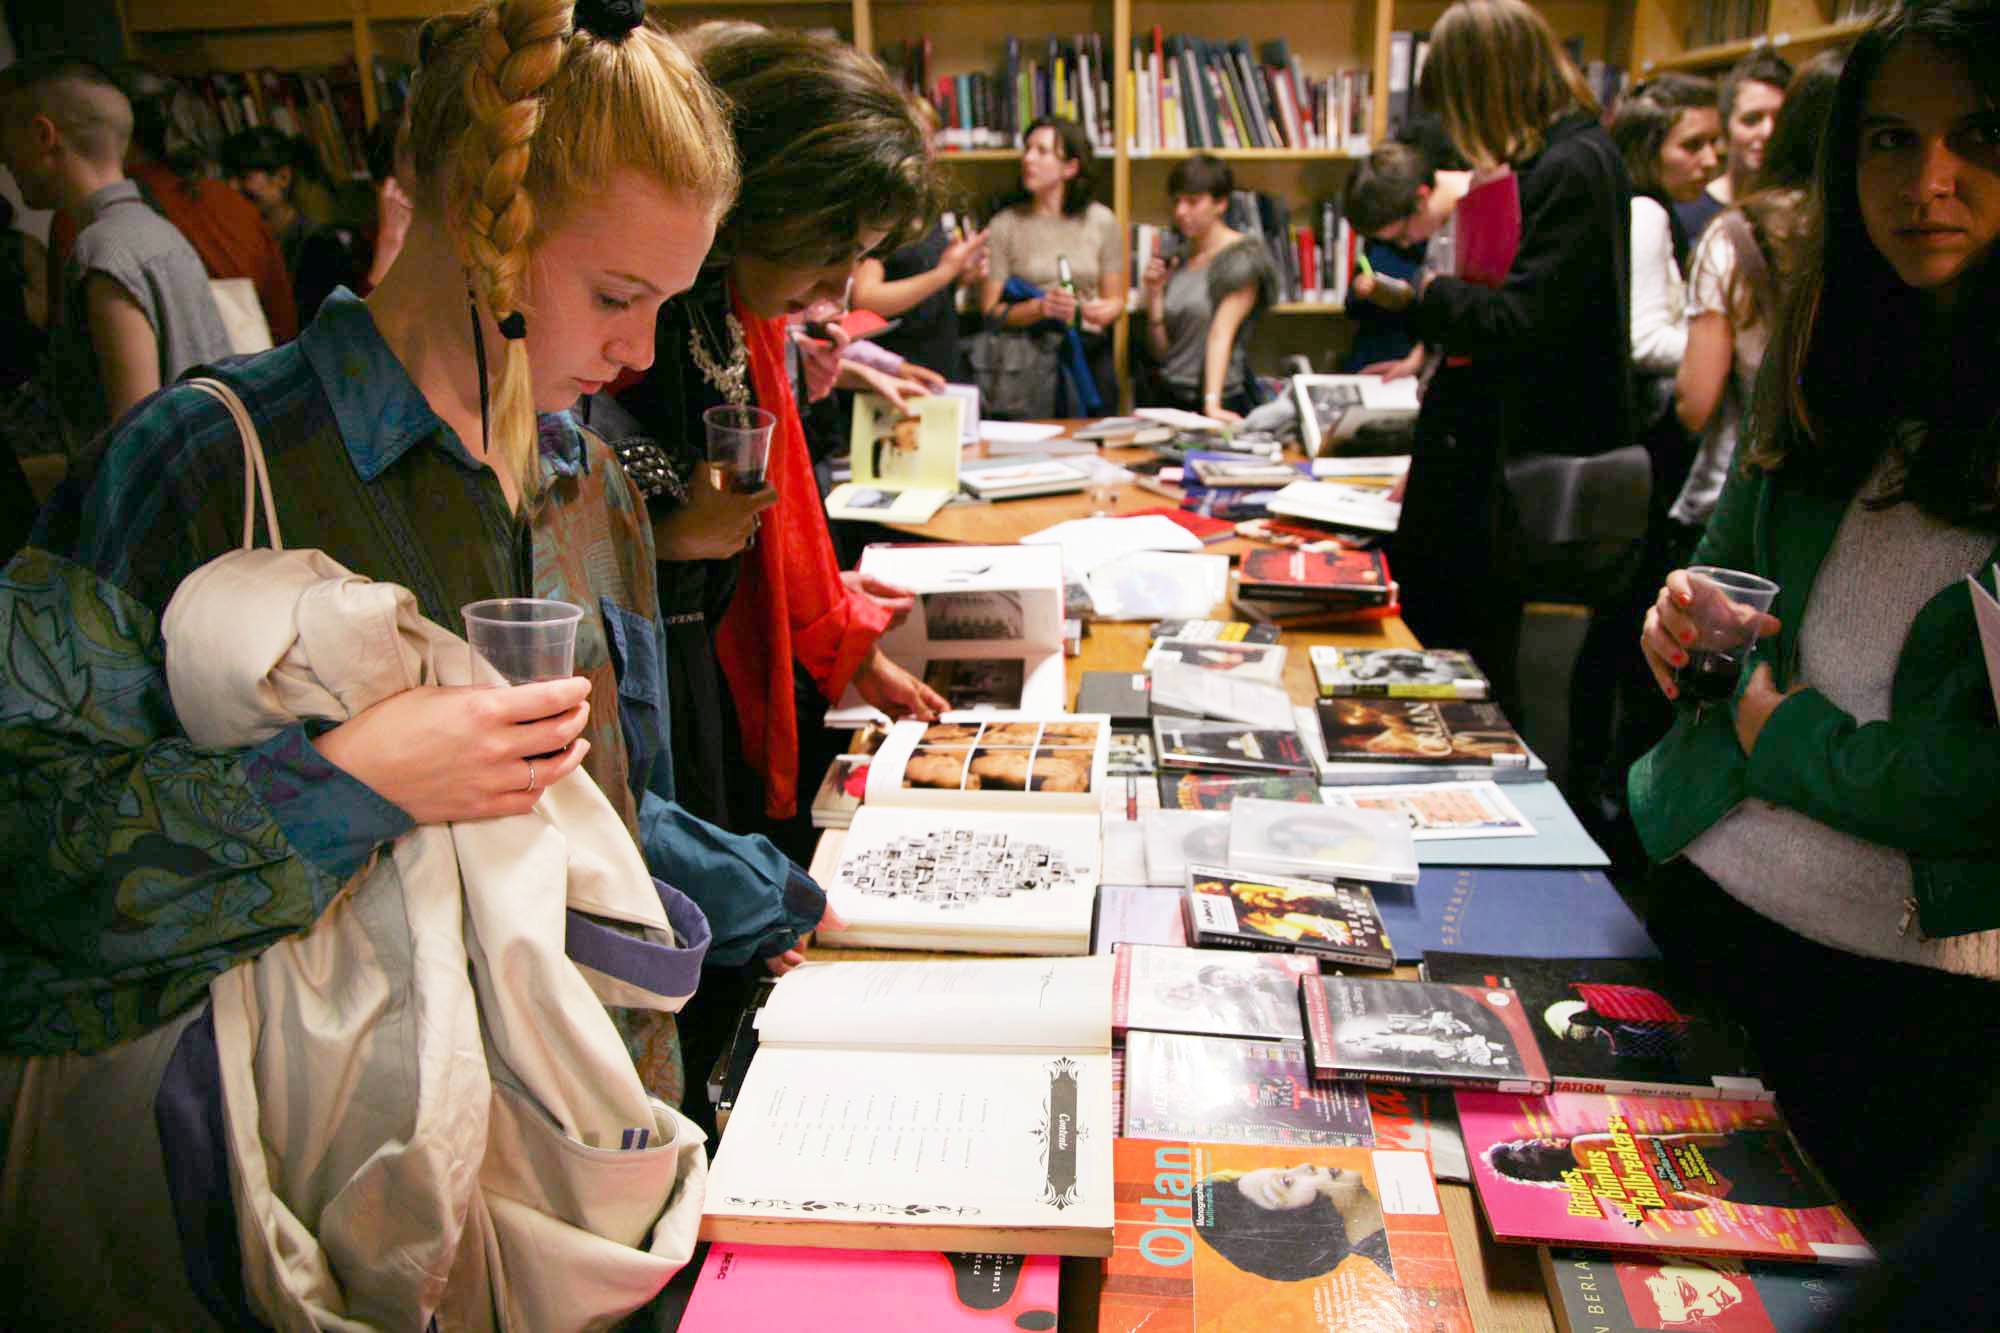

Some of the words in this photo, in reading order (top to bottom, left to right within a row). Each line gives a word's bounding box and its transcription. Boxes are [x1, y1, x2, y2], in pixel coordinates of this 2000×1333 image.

[1058, 1113, 1071, 1150] Contents
[1583, 1149, 1628, 1199] Bimbos
[1139, 1146, 1193, 1267] Orlan
